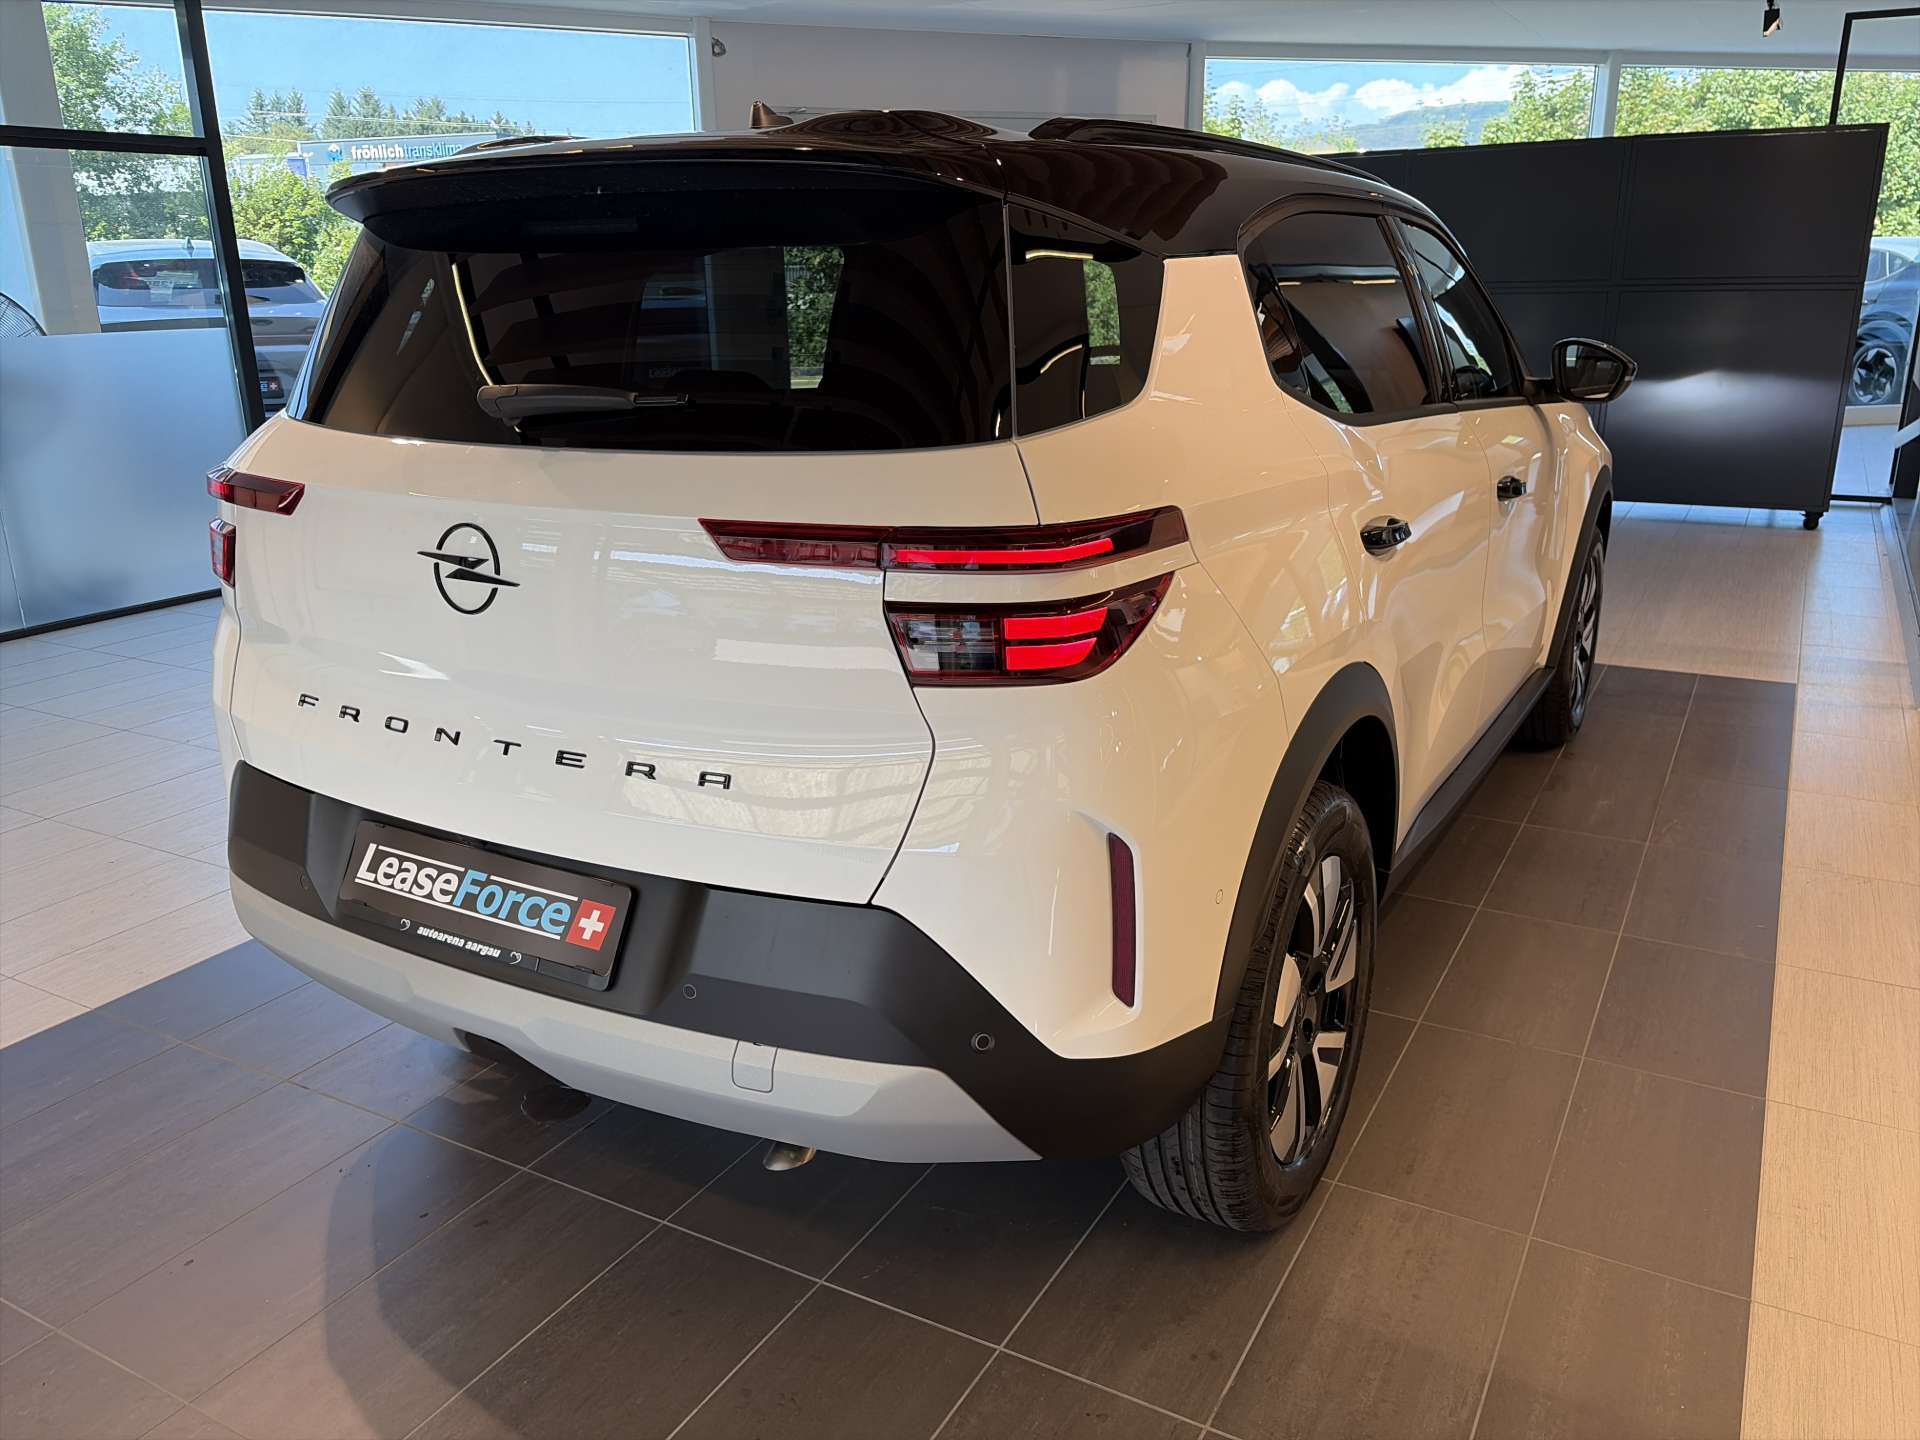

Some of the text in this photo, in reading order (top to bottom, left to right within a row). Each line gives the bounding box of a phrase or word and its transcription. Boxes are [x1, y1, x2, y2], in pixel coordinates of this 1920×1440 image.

[298, 693, 732, 790] FRONTERA
[416, 926, 501, 957] autoarena aargau
